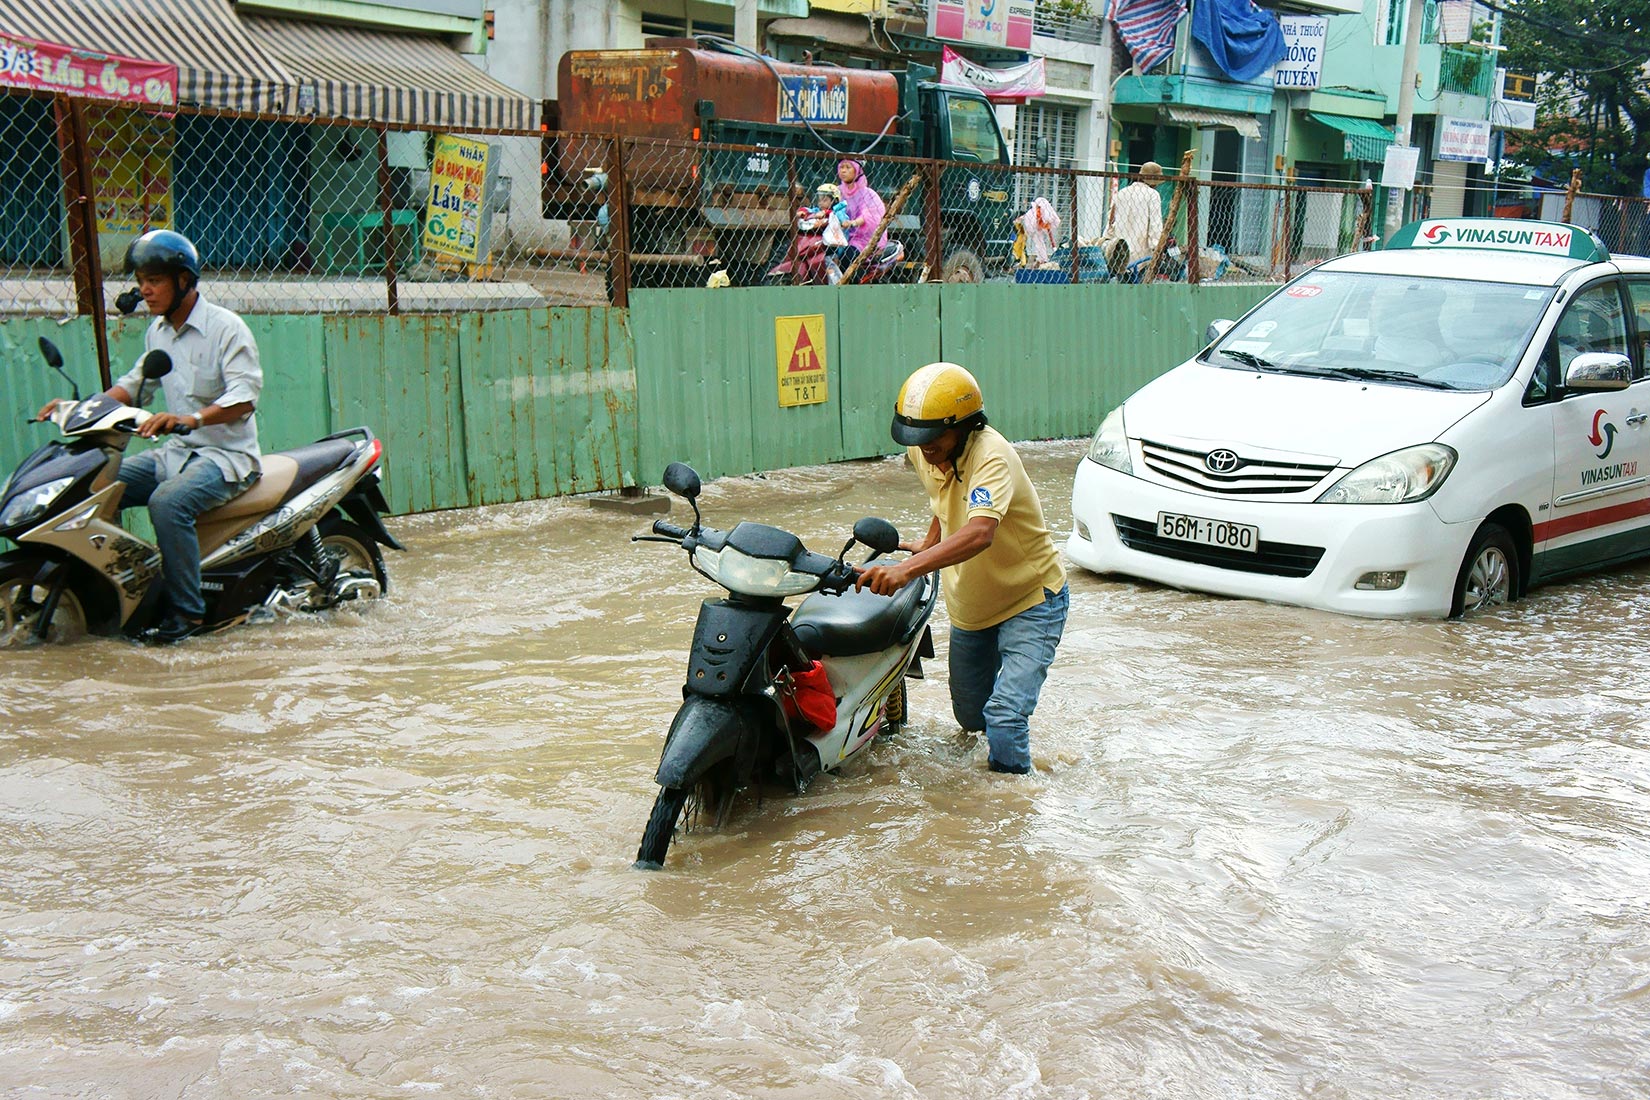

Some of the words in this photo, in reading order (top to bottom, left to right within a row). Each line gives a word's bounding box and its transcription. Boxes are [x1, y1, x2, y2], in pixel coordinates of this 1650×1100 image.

[1009, 6, 1033, 17] EXPRESS
[967, 19, 985, 30] SHOP
[992, 22, 1003, 33] GO
[1300, 21, 1324, 37] THUỐC
[1276, 64, 1318, 87] TUYẾN
[781, 89, 795, 119] XE
[798, 79, 819, 119] CHỞ
[820, 84, 845, 119] NƯỚC
[460, 145, 484, 162] NHÂN
[428, 212, 458, 241] Ốc
[794, 387, 801, 401] T
[803, 386, 809, 400] &
[811, 385, 816, 399] T
[199, 581, 224, 591] AMAHA
